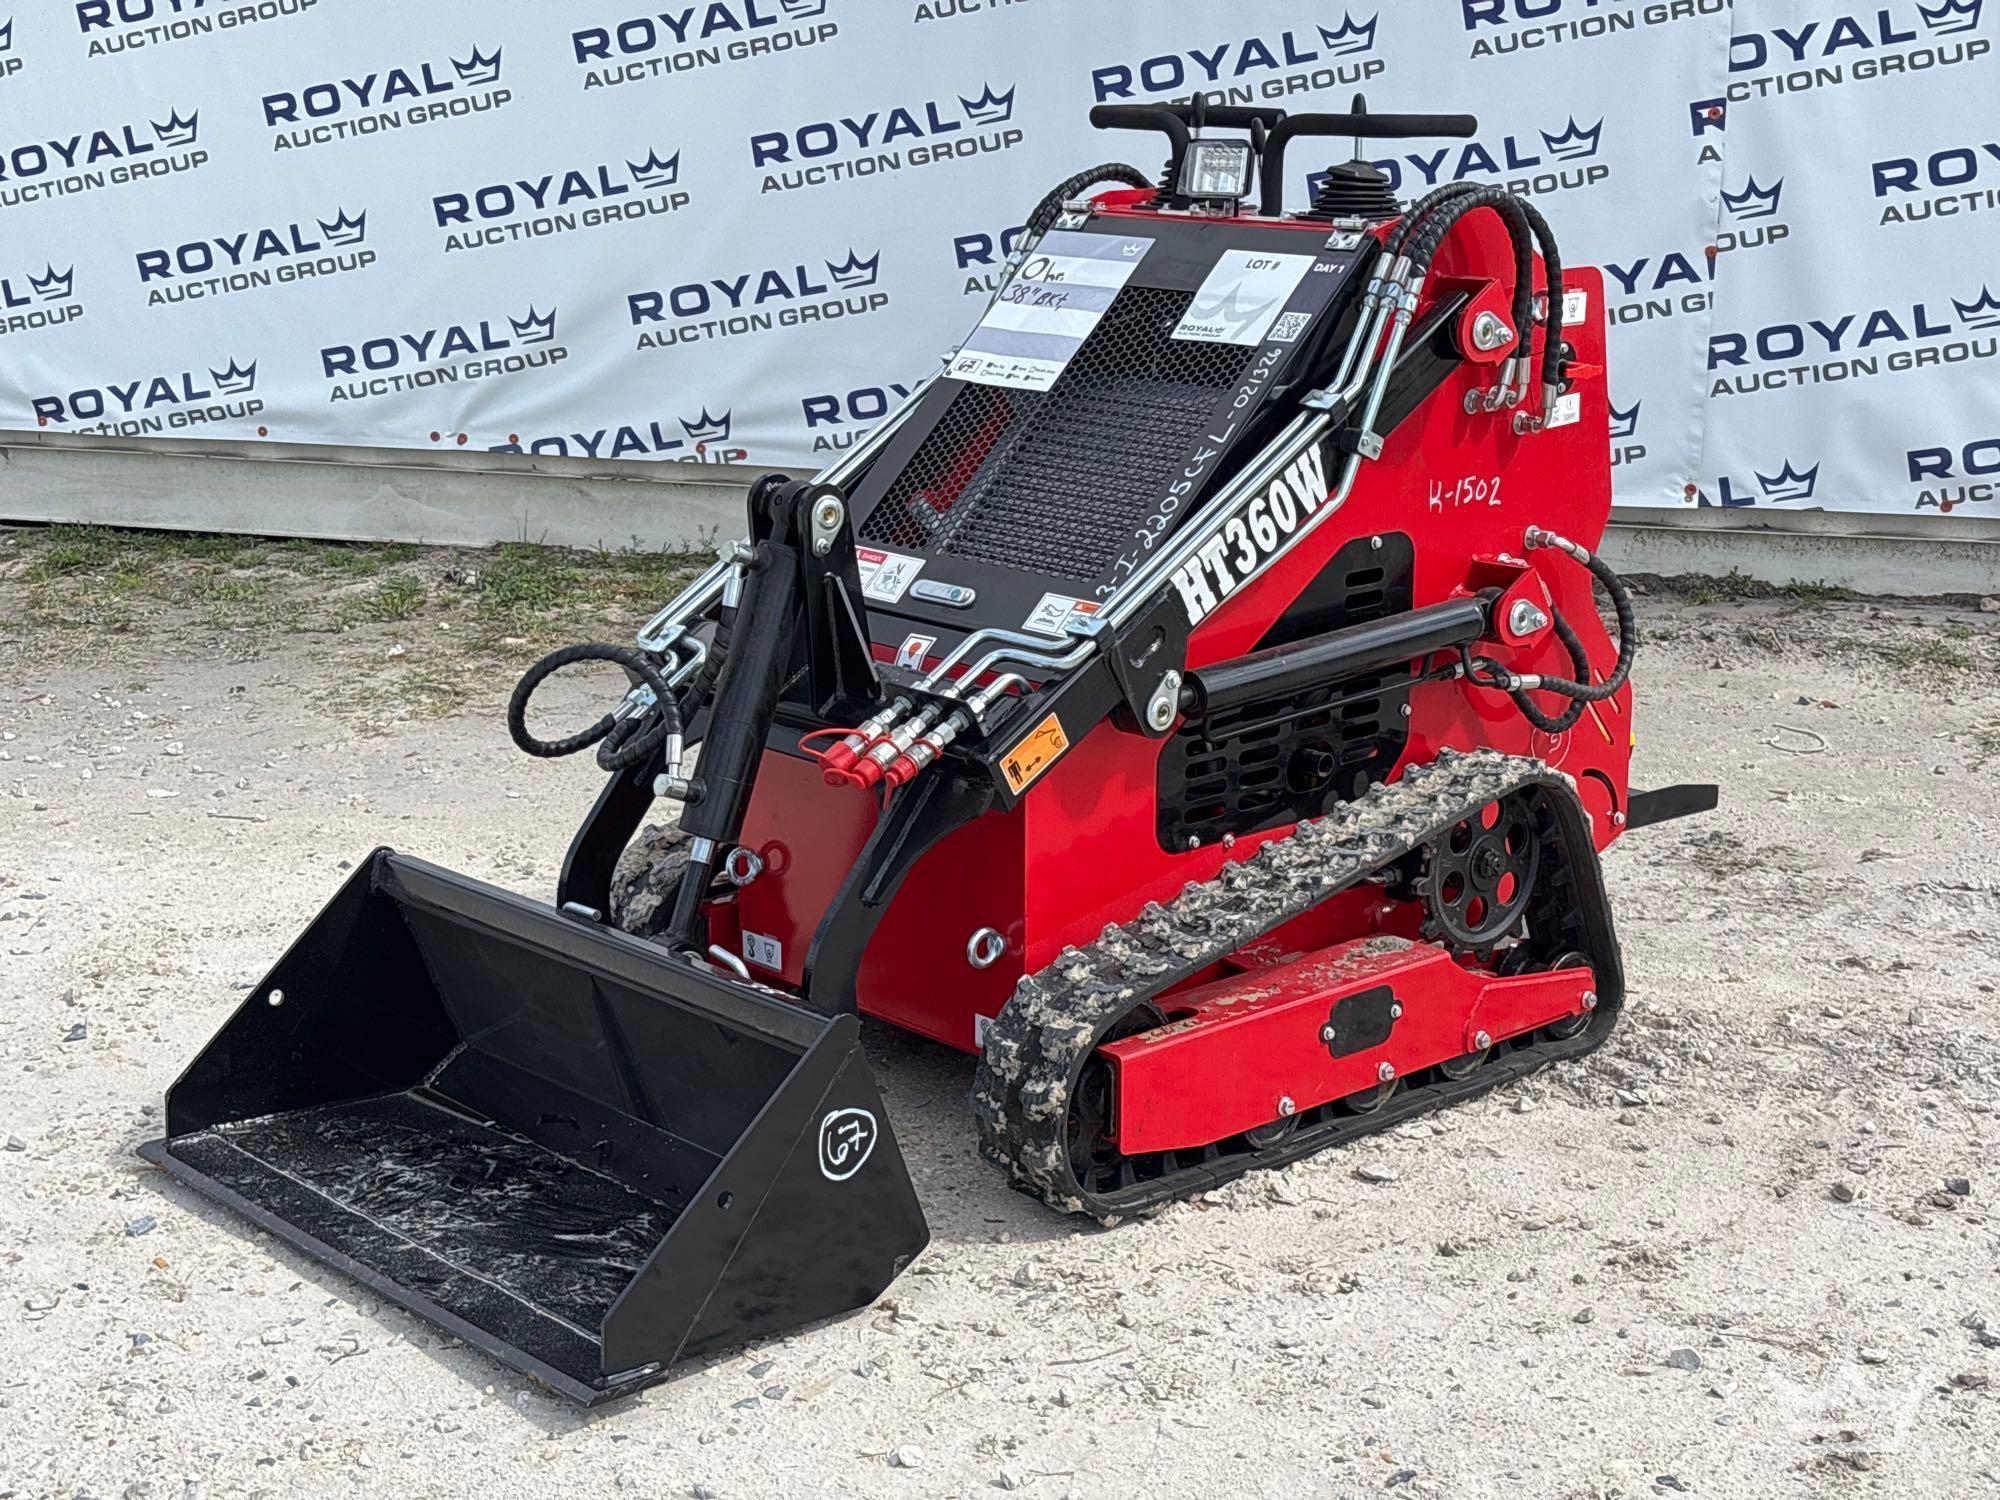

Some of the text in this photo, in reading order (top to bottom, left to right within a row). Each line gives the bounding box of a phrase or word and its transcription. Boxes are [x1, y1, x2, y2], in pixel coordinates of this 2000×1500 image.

[88, 15, 213, 58] AUCTION
[572, 0, 778, 64] ROYAL
[583, 22, 839, 91] AUCTION GROUP
[1470, 10, 1635, 59] AUCTION
[1728, 10, 1918, 73] OYAL
[262, 63, 454, 127] ROYAL
[1091, 31, 1319, 102] ROYAL
[1261, 59, 1385, 99] GROUP
[1727, 39, 1991, 102] CTION GROUP
[273, 88, 512, 152] AUCTION GROUP
[750, 101, 961, 168] ROYAL
[0, 125, 154, 182] OYAL
[0, 150, 209, 208] UCTION GROUP
[760, 128, 1024, 194] AUCTION GROUP
[432, 164, 629, 228] ROYAL
[444, 191, 690, 252] AUCTION GROUP
[1879, 189, 2000, 227] AUCTI
[136, 223, 321, 283] ROYAL
[148, 250, 377, 307] AUCTION GROUP
[1245, 258, 1273, 270] LOT
[1313, 263, 1345, 274] DAY 1
[628, 265, 828, 326] ROYAL
[636, 292, 889, 351] AUCTION GROUP
[320, 320, 510, 378] ROYAL
[1180, 324, 1213, 333] ROYAL
[1707, 304, 1953, 371] ROYAL
[329, 346, 568, 402] AUCTION GROUP
[1710, 338, 2000, 398] AUCTION GROU
[32, 372, 211, 424] ROYAL
[168, 399, 264, 428] GROUP
[1429, 476, 1502, 514] K-1502
[1170, 442, 1328, 626] HT360W
